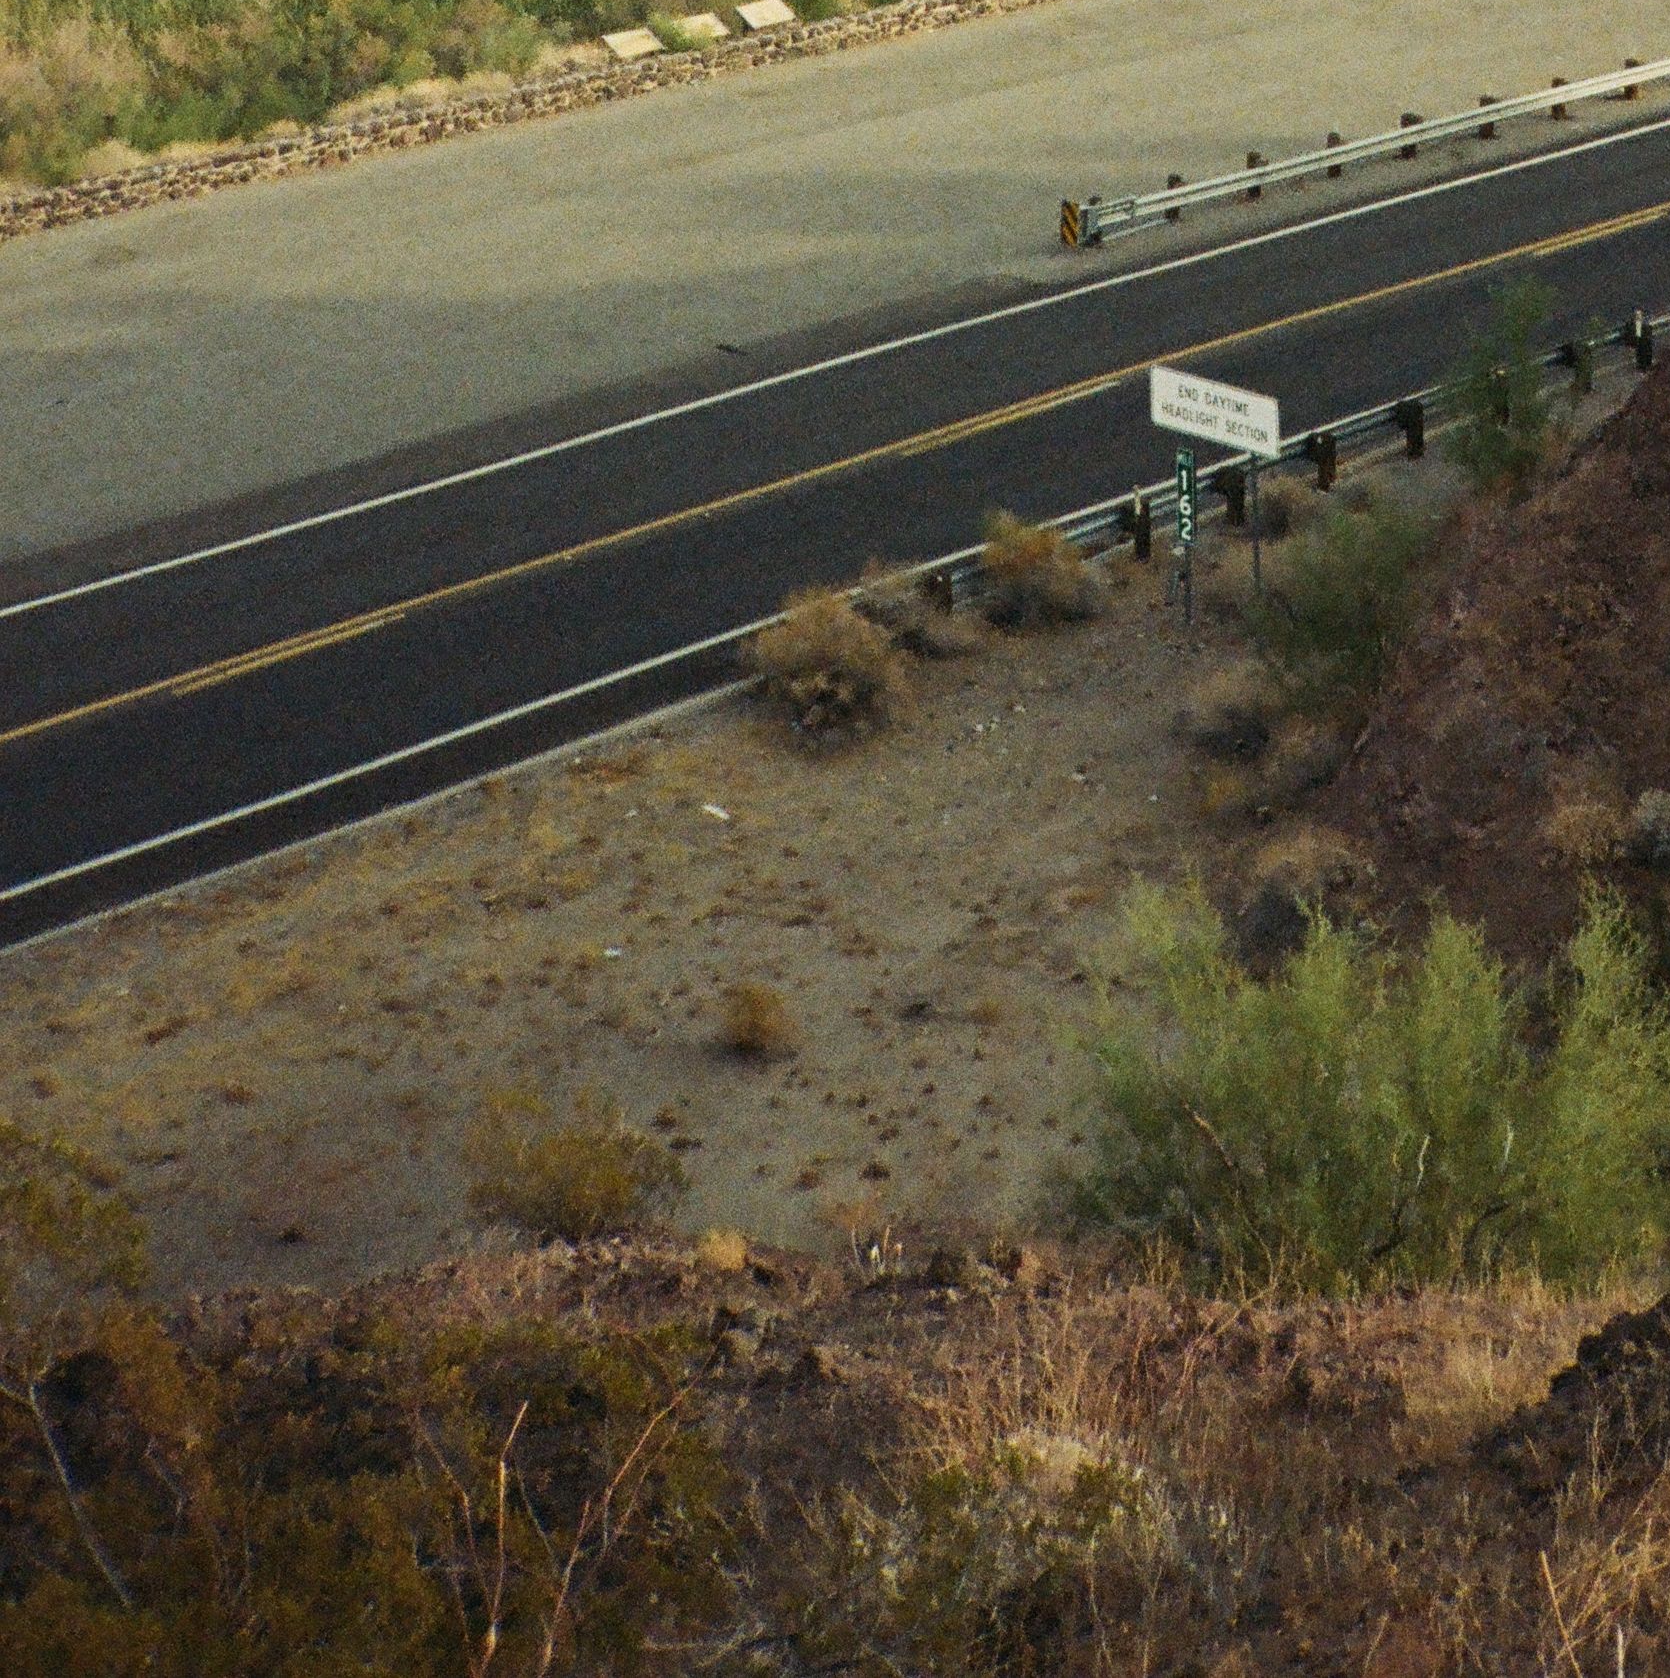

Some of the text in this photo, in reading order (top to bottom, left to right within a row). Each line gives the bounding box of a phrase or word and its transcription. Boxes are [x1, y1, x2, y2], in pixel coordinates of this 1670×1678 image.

[1178, 385, 1250, 416] END DAYTIME
[1161, 403, 1268, 443] HEADLIGHT SECTION
[1179, 470, 1192, 541] 162
